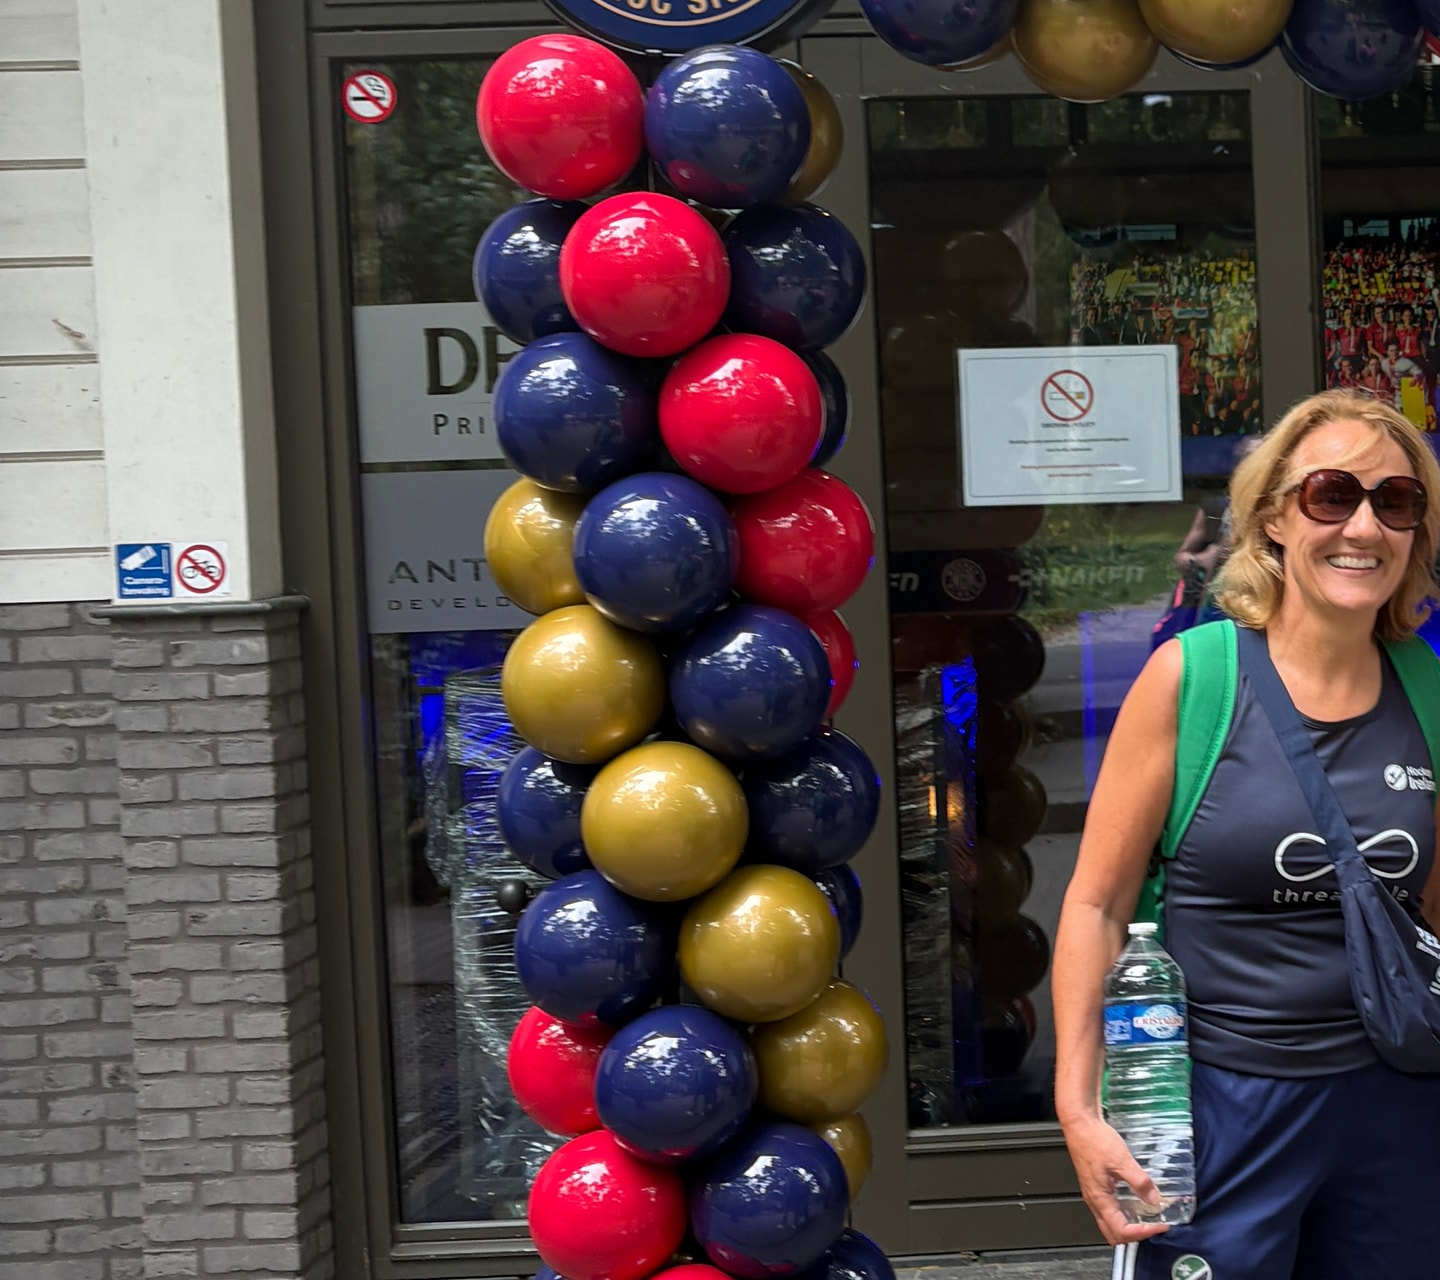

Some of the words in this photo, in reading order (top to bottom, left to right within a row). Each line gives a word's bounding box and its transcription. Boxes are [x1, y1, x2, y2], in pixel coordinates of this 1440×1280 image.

[433, 413, 486, 436] PRI
[388, 558, 488, 584] ANT
[388, 596, 512, 611] DEVELO
